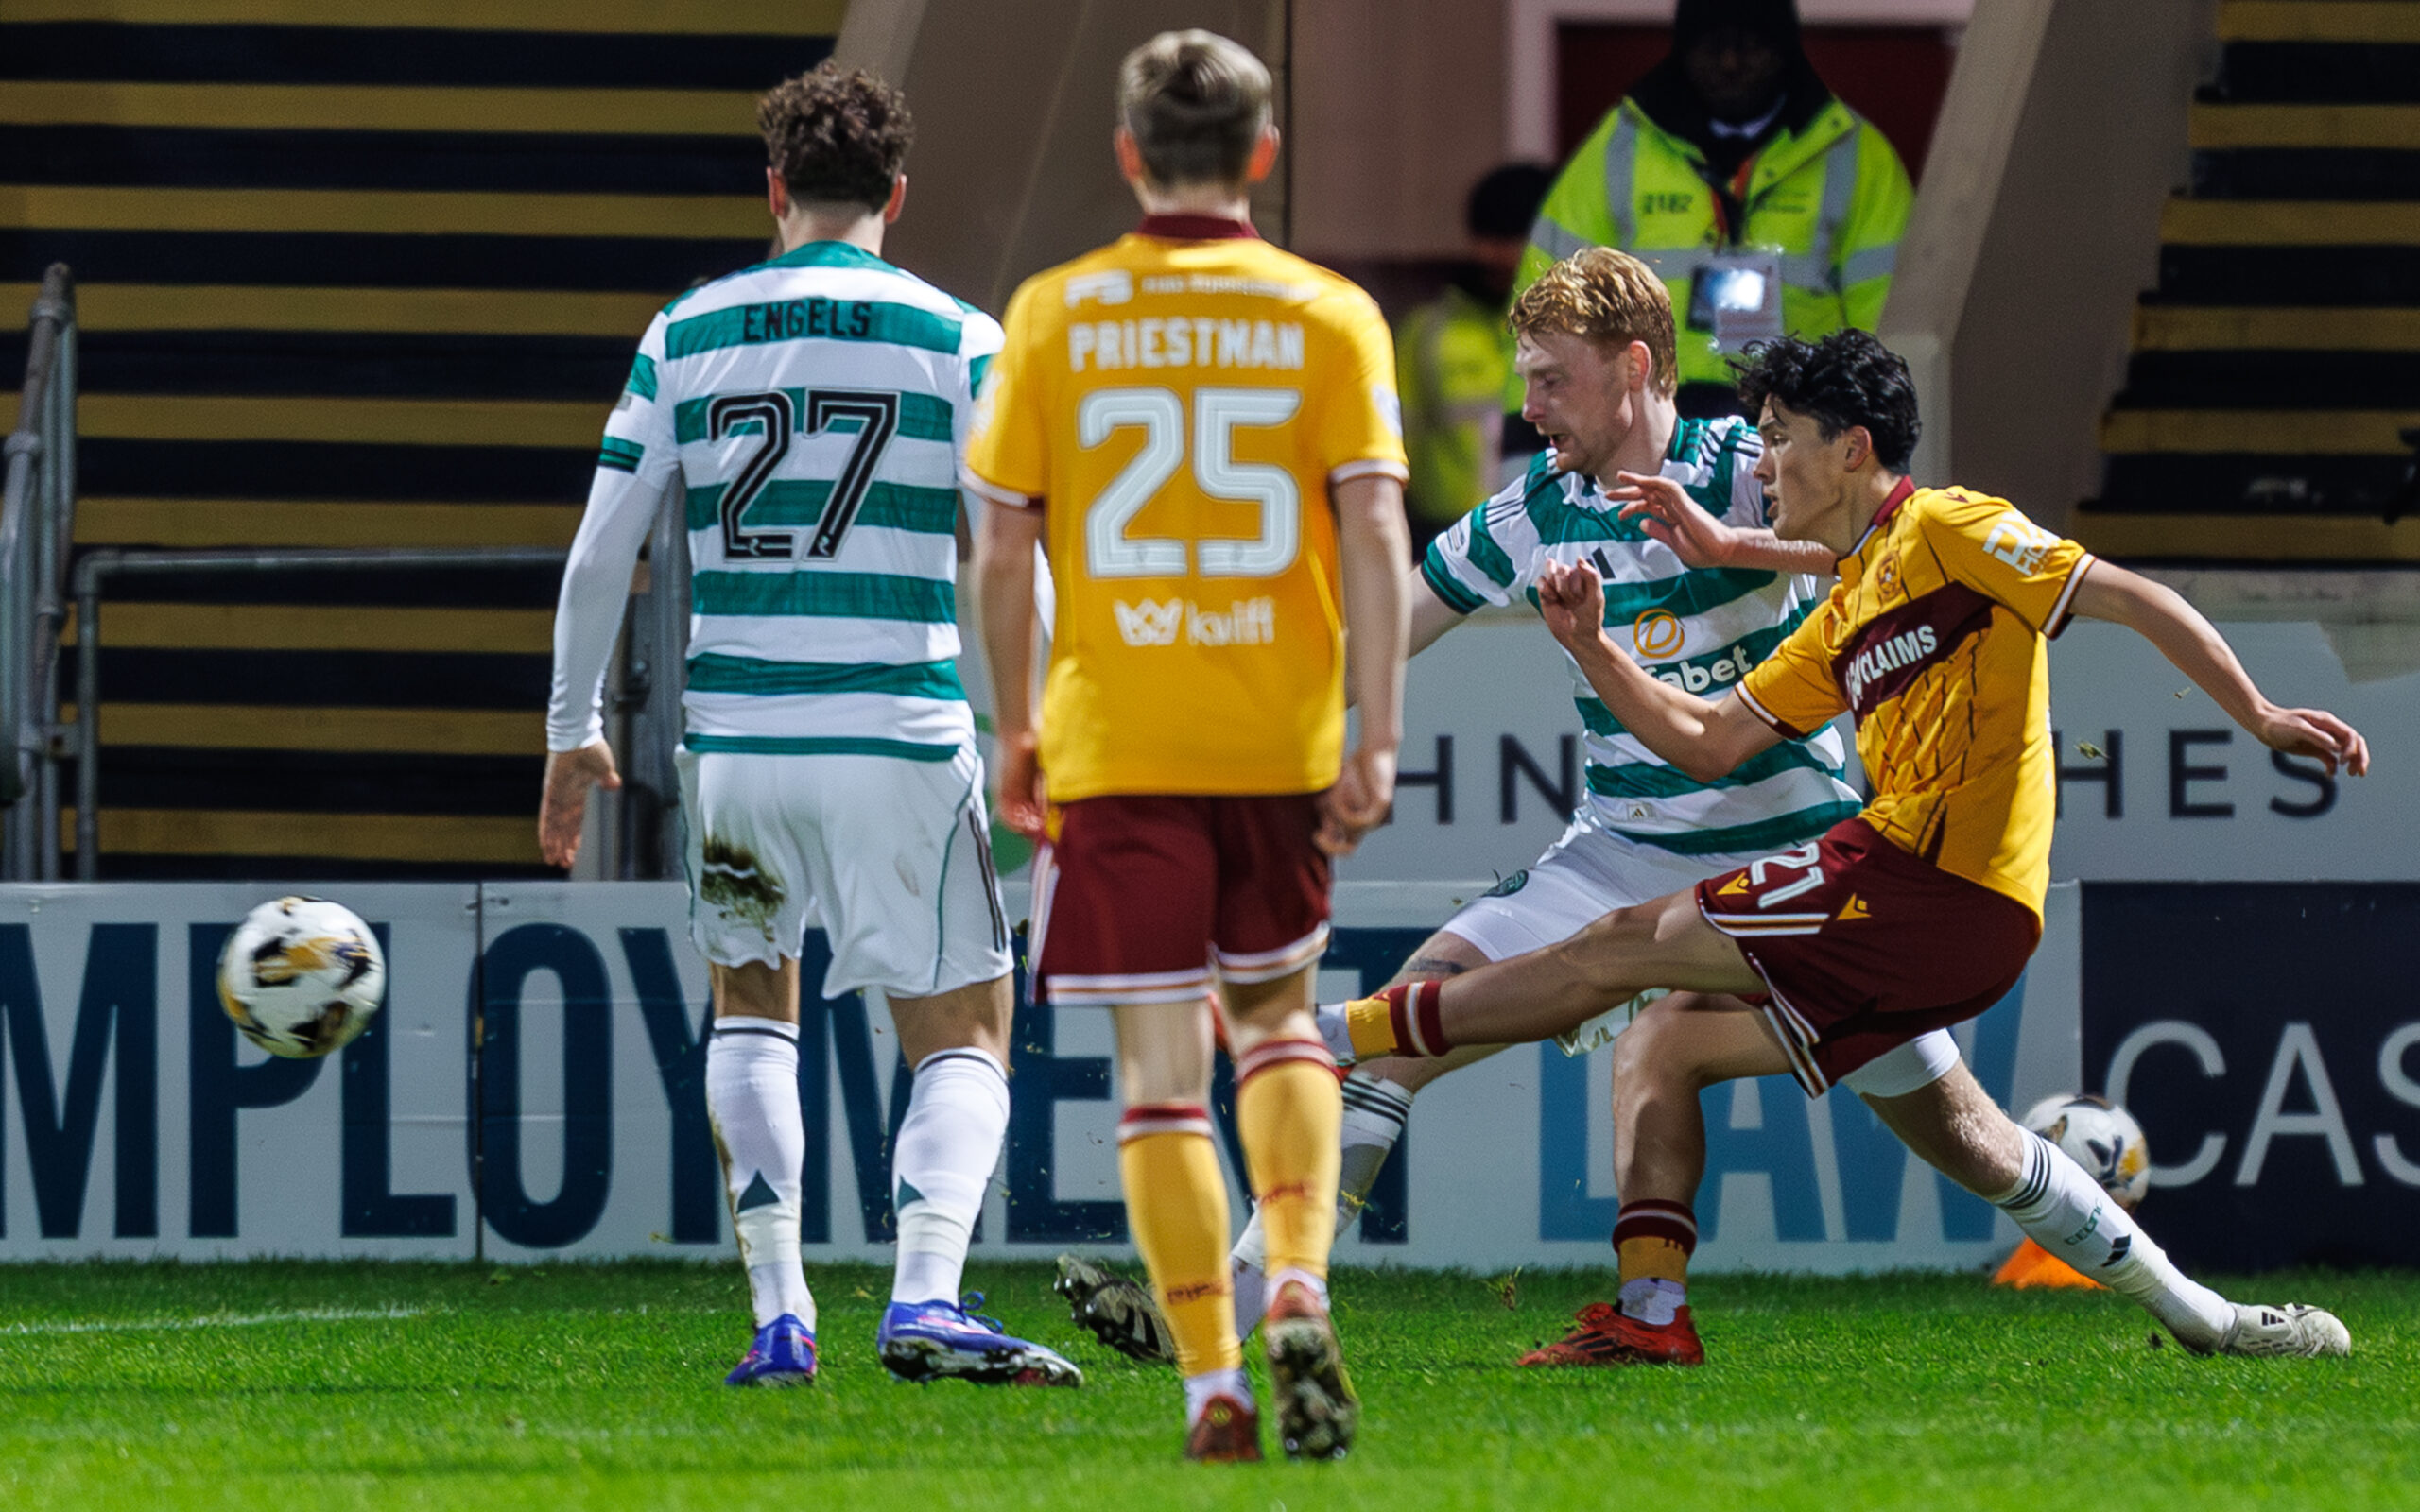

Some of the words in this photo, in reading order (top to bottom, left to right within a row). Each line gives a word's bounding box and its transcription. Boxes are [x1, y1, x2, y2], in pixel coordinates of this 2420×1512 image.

[742, 301, 872, 342] ENGELS
[1068, 316, 1305, 374] PRIESTMAN
[707, 388, 901, 563] 27
[1077, 386, 1302, 579] 25
[1750, 840, 1825, 909] 21
[1540, 964, 2029, 1244] LAW
